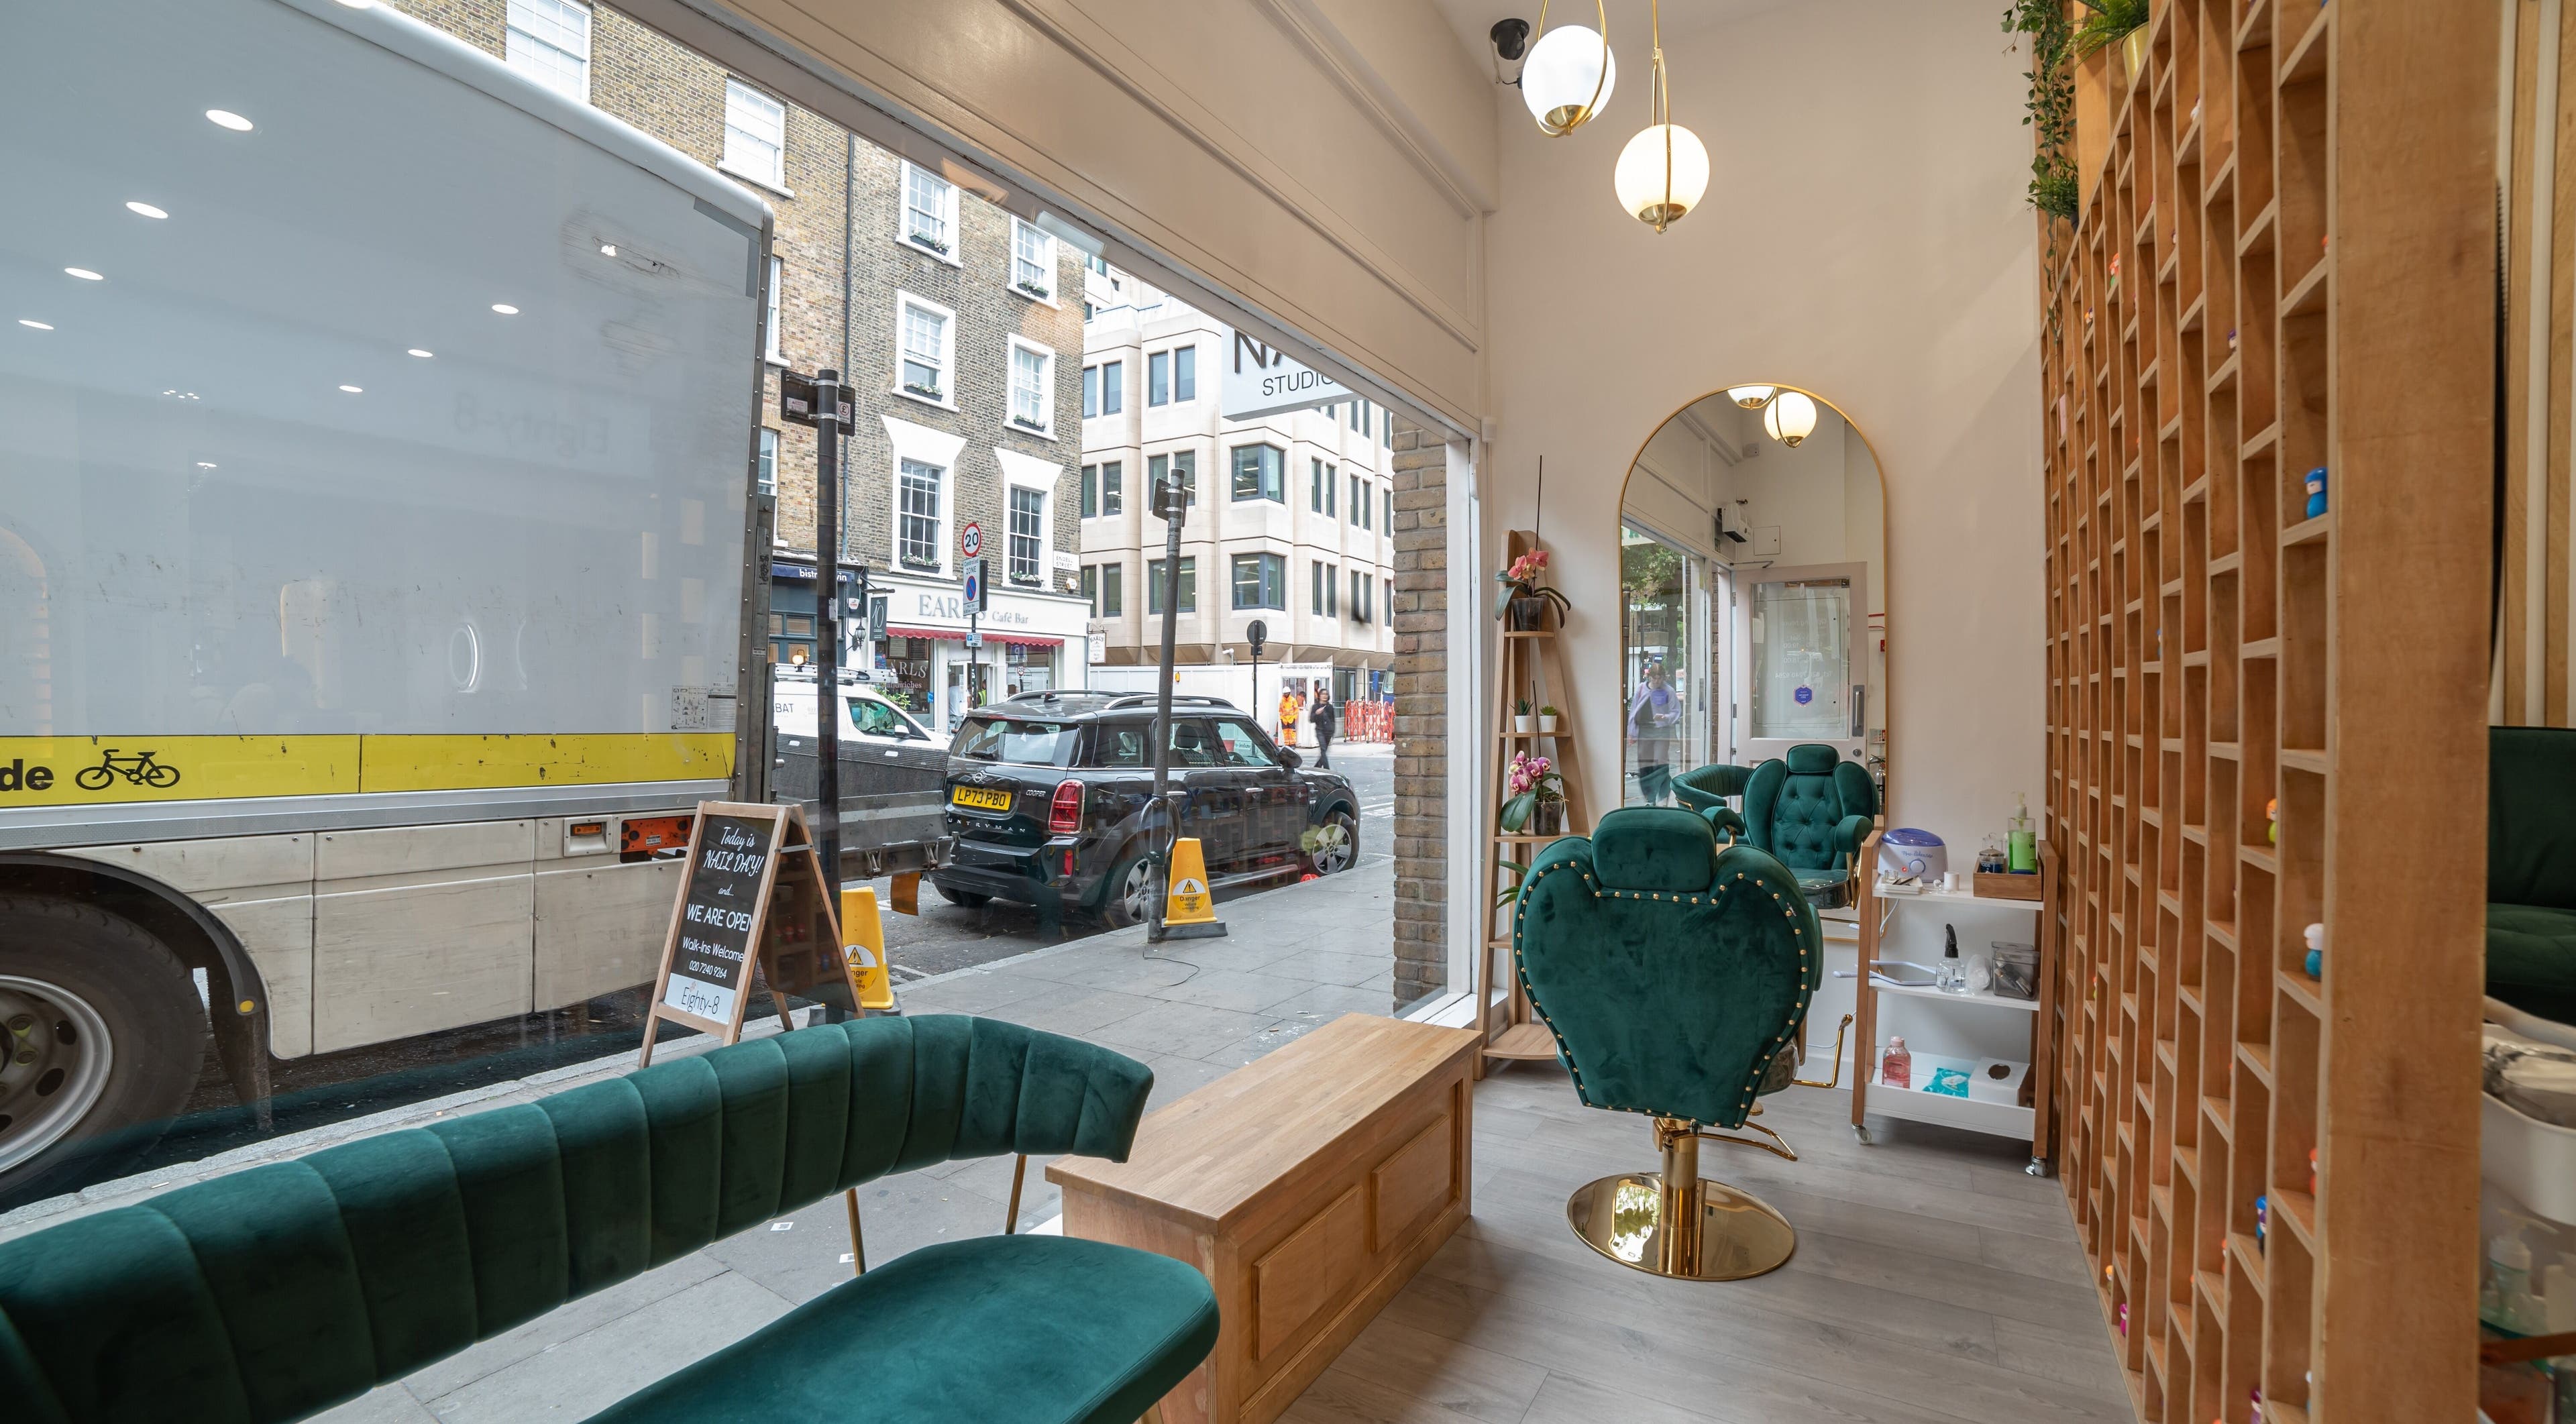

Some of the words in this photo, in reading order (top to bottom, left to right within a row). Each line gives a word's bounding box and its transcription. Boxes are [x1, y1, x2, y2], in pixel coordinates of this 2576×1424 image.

[965, 532, 979, 548] 20
[964, 558, 979, 567] Controlled
[966, 565, 977, 576] ZONE
[871, 604, 884, 628] 10
[1015, 613, 1030, 625] Bar
[774, 703, 794, 714] BAT
[957, 788, 984, 804] LP73
[985, 792, 1006, 807] PBO
[1026, 789, 1046, 798] COOPER
[720, 826, 745, 851] Today
[746, 833, 755, 848] is
[702, 849, 735, 871] NAIL
[733, 853, 765, 877] DAY!
[687, 903, 704, 922] WE
[703, 907, 726, 926] ARE
[682, 936, 711, 955] Walk-Ins
[712, 942, 745, 963] Welcome
[688, 959, 700, 971] 020
[698, 963, 714, 976] 7240
[713, 966, 727, 979] 9264
[681, 987, 720, 1015] Eighty-8
